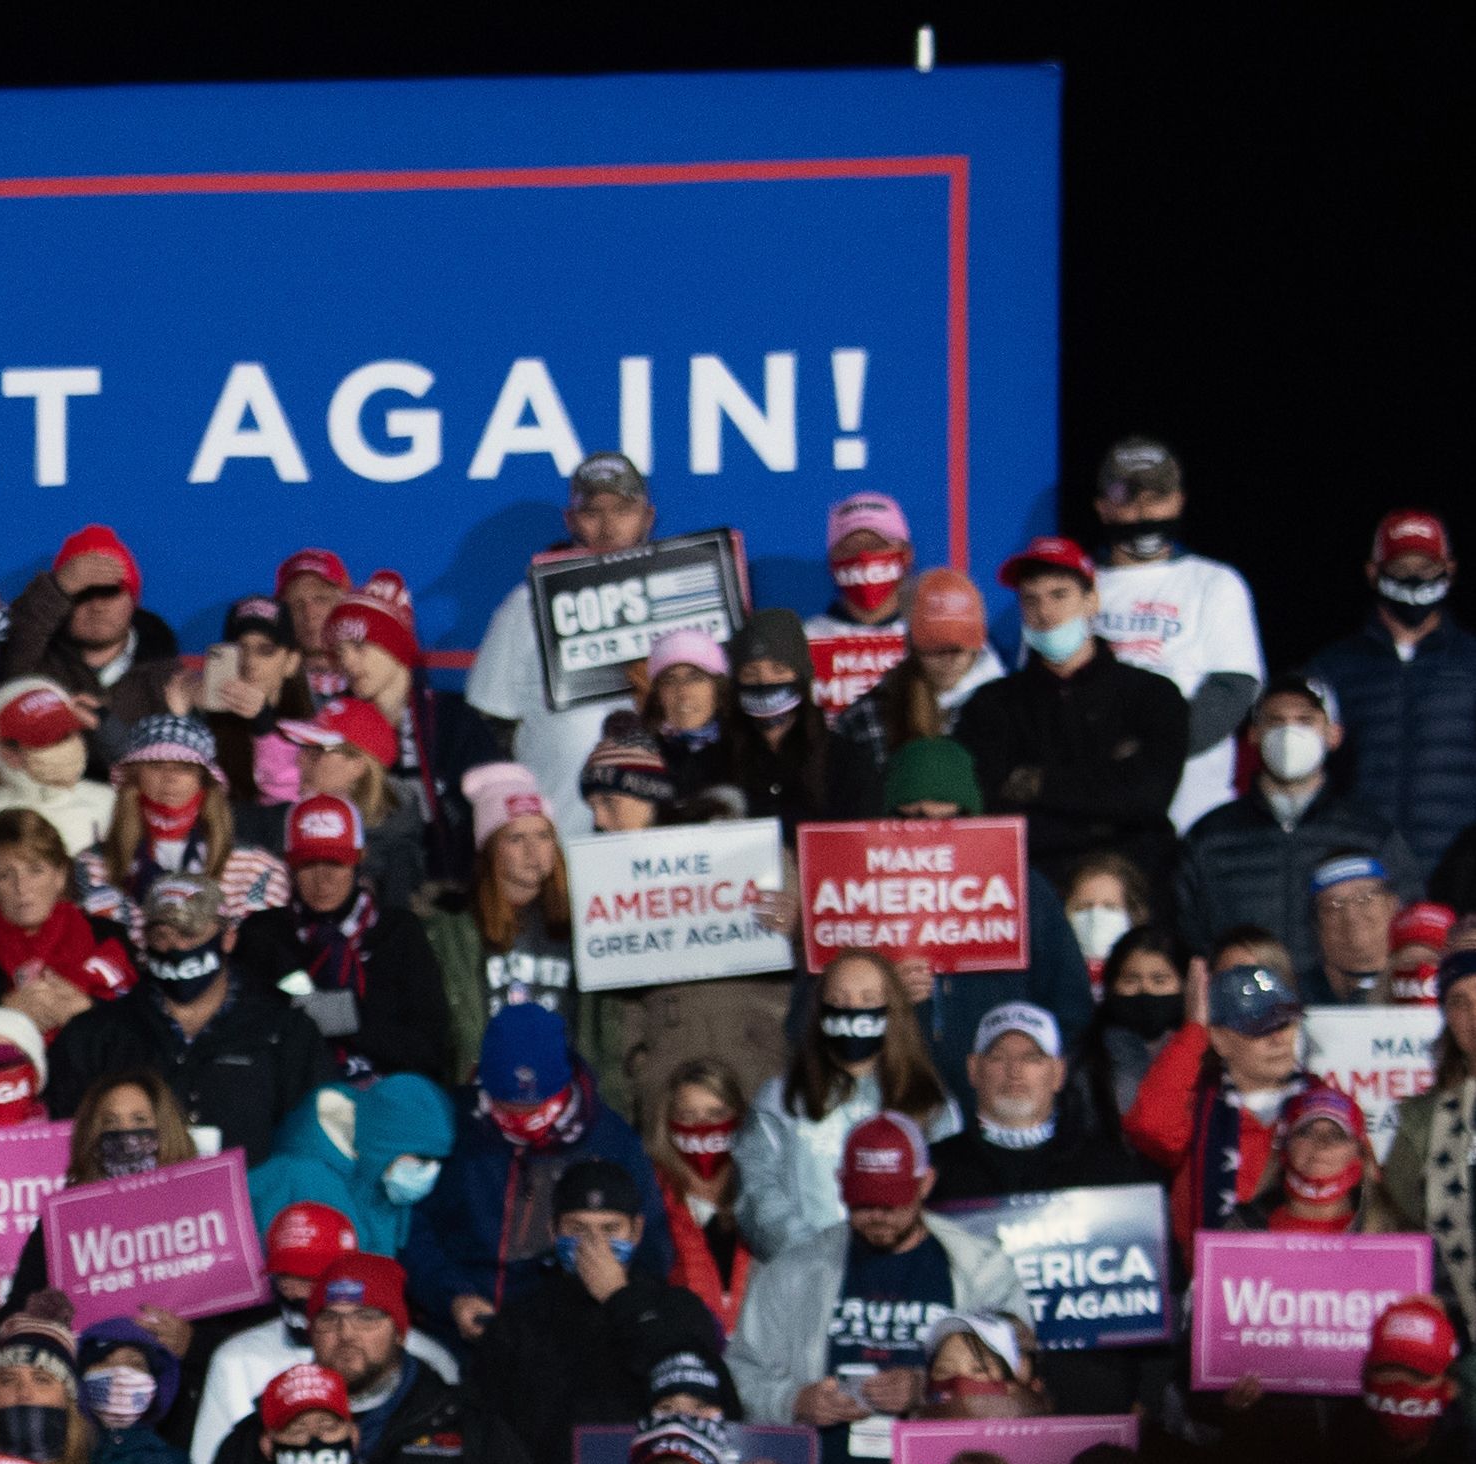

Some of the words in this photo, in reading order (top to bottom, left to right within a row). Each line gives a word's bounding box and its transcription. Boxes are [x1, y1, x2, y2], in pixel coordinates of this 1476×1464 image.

[187, 345, 871, 484] AGAIN!
[553, 583, 648, 636] COPS
[563, 639, 620, 663] FOR
[632, 856, 709, 878] MAKE
[866, 849, 953, 872] MAKE
[585, 880, 756, 925] AMERICA
[814, 878, 1015, 912] AMERICA
[587, 926, 675, 958] GREAT
[814, 922, 909, 948] GREAT
[919, 918, 1014, 944] AGAIN
[69, 1209, 226, 1275] Women
[88, 1270, 132, 1294] FOR
[140, 1254, 217, 1280] TRUMP
[841, 1301, 951, 1326] TRUMP
[1058, 1290, 1158, 1320] AGAIN
[1241, 1332, 1291, 1347] FOR
[1302, 1332, 1369, 1347] TRUM
